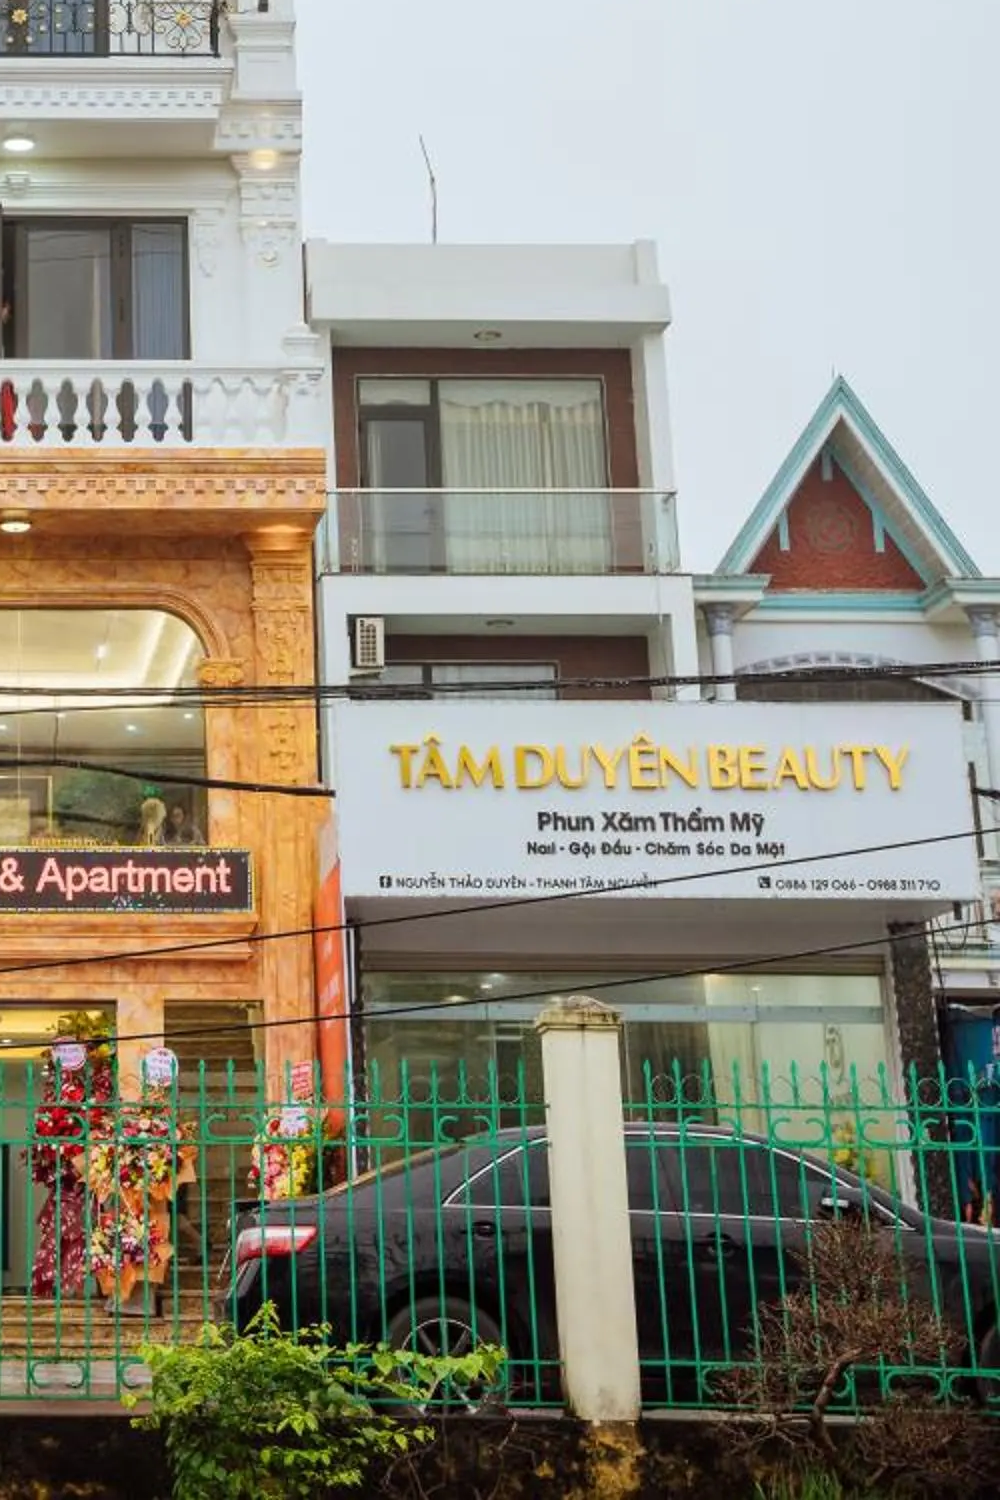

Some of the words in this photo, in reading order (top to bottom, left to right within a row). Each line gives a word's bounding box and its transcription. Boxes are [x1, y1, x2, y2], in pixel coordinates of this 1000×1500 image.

[389, 732, 505, 790] TÂM
[514, 730, 698, 790] DUYÊN
[706, 743, 908, 791] BEAUTY
[537, 811, 595, 831] Phun
[600, 811, 656, 832] Xăm
[659, 807, 725, 832] Thẩm
[729, 812, 765, 837] Mỹ
[527, 841, 556, 855] Nail
[569, 841, 596, 859] Gội
[645, 841, 691, 856] Chăm
[696, 841, 725, 856] Sóc
[730, 842, 751, 856] Da
[36, 857, 231, 900] Apartment
[537, 878, 577, 889] THANH
[811, 878, 829, 891] 129
[831, 878, 857, 891] 066
